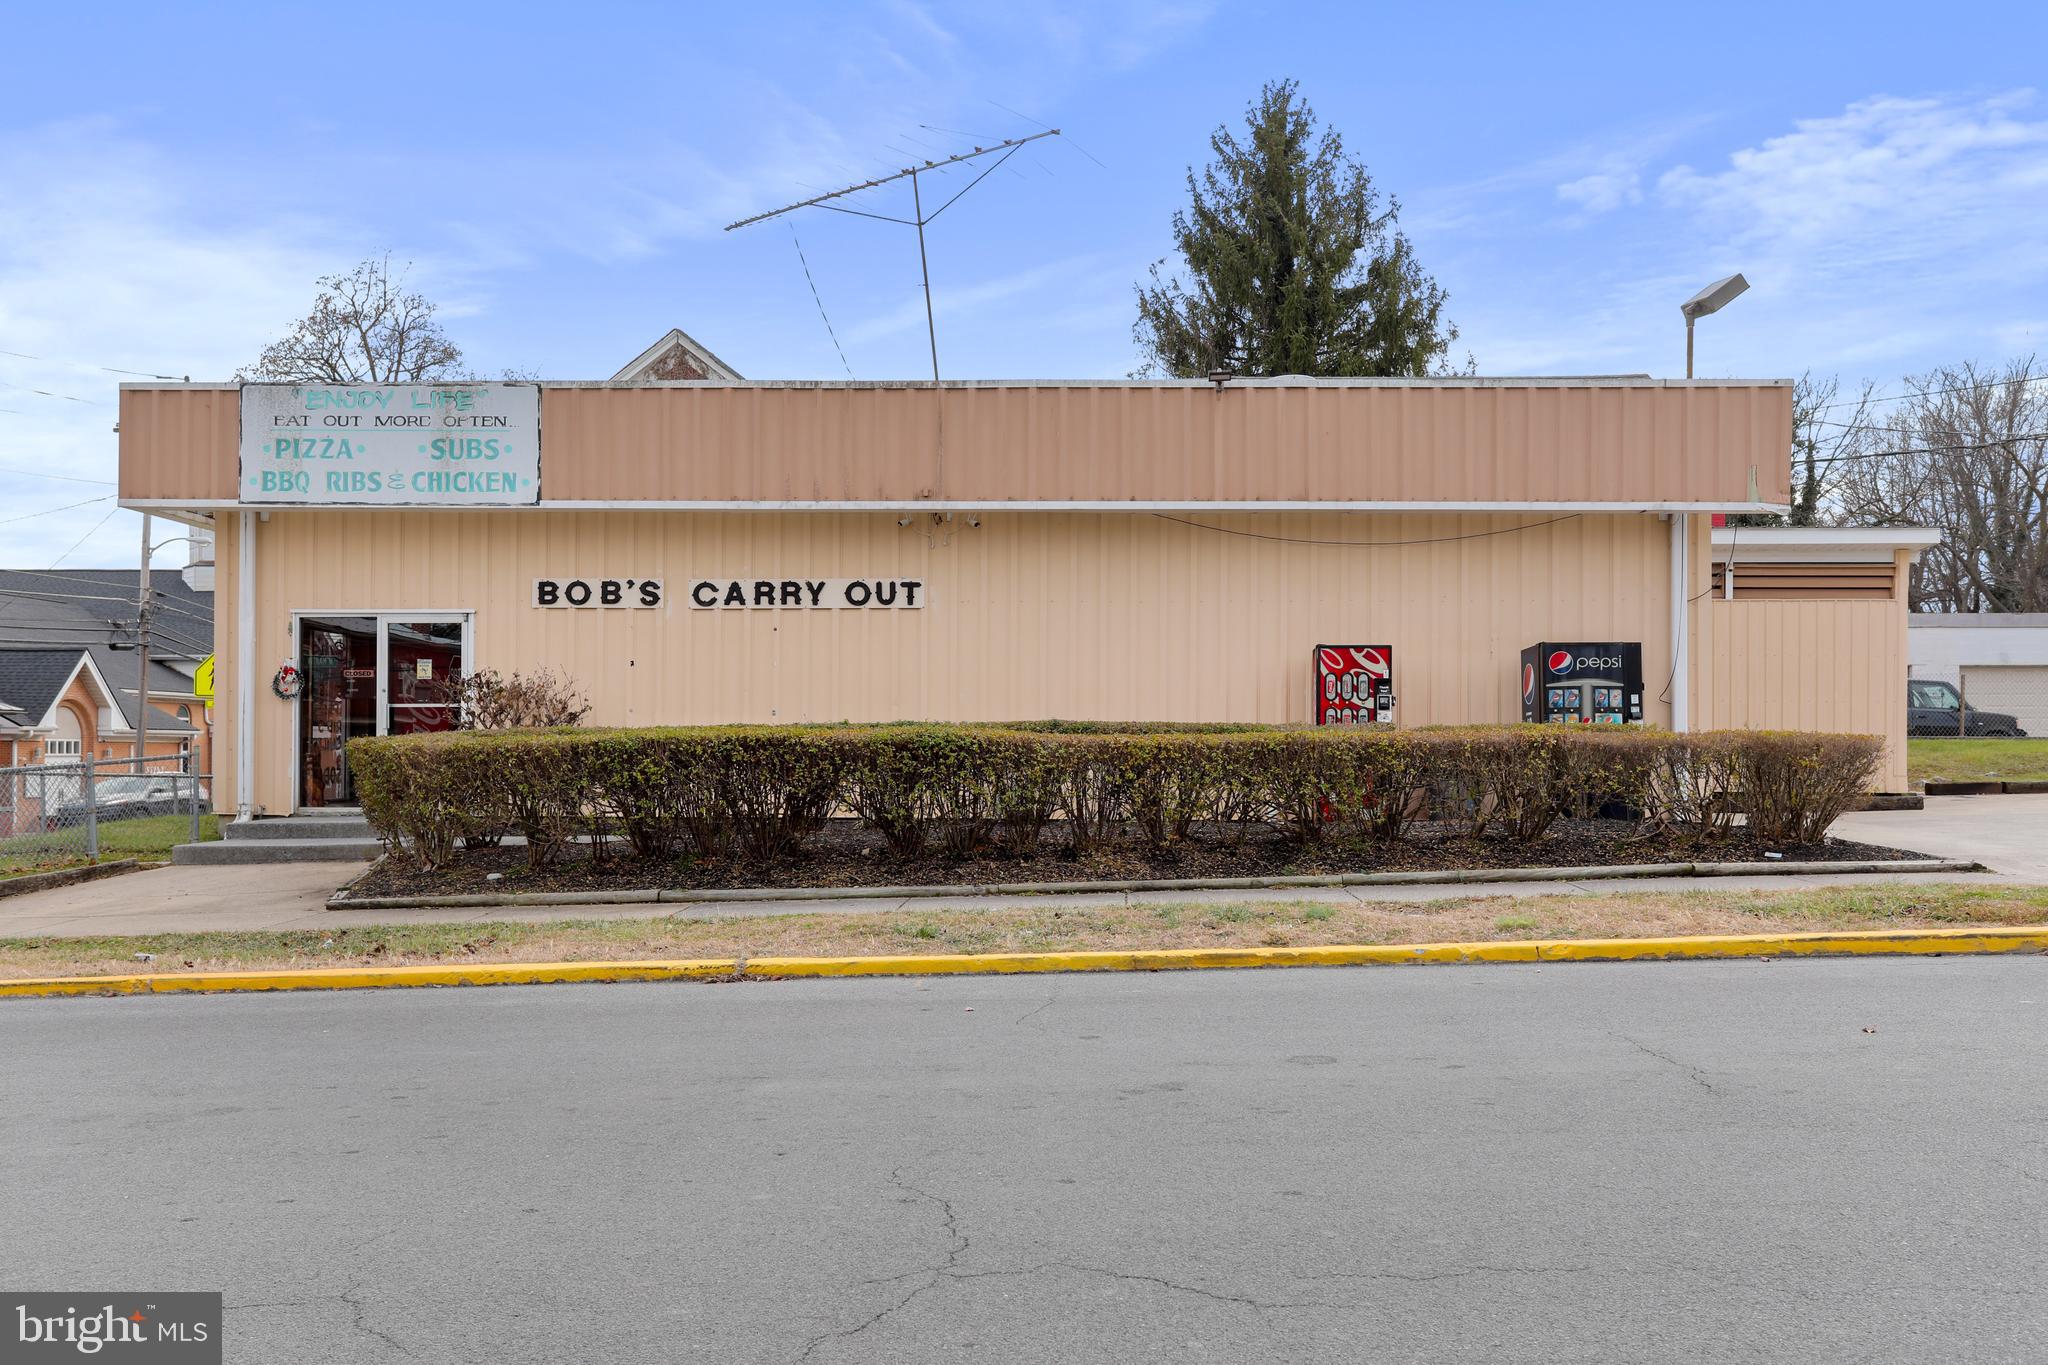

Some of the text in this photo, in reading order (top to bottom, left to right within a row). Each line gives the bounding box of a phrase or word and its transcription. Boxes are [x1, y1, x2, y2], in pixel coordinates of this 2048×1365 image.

[323, 415, 362, 427] OUT
[374, 415, 431, 427] MORE
[274, 437, 500, 460] PIZZA SUBS
[261, 470, 310, 494] BBQ
[326, 471, 382, 493] RIBS
[411, 471, 517, 493] CHICKEN
[537, 579, 922, 607] BOB'S CARRY OUT
[1576, 655, 1622, 671] pepsi
